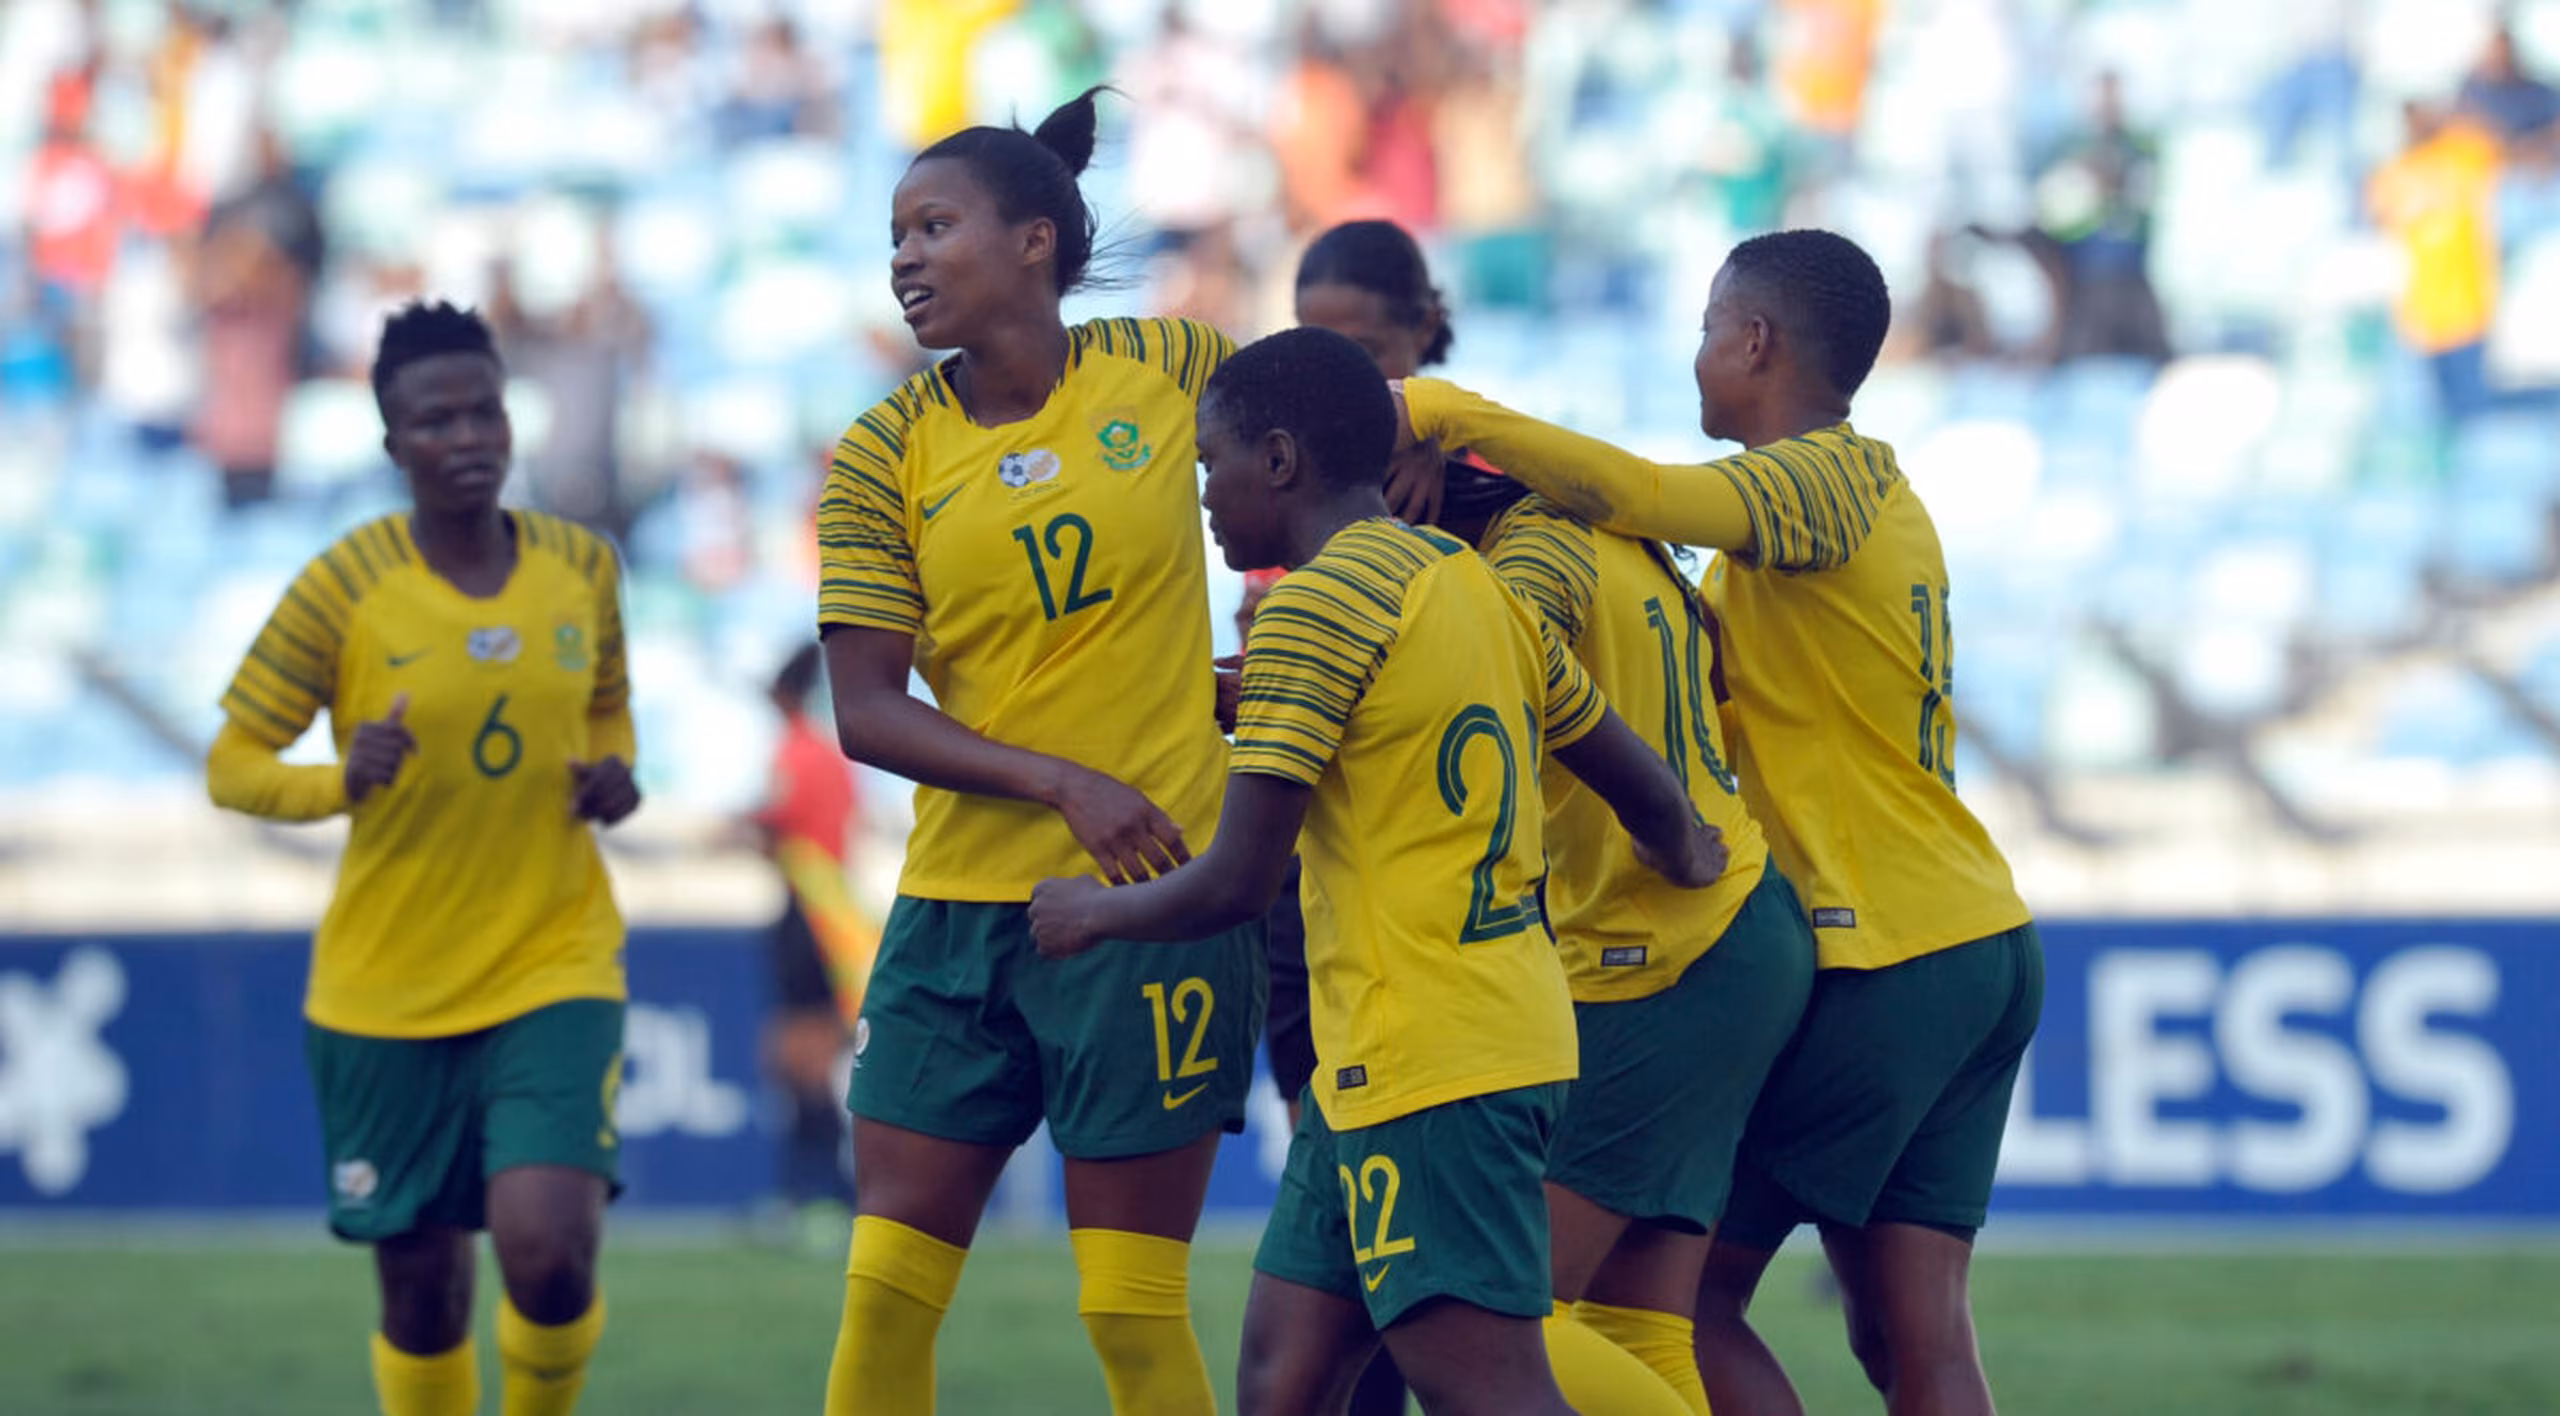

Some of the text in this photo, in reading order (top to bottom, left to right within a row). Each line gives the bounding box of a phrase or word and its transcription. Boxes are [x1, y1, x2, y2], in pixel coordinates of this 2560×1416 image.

[1012, 513, 1113, 621] 12
[472, 692, 523, 779] 6
[1436, 703, 1541, 944] 2
[1142, 976, 1218, 1082] 12
[1339, 1154, 1416, 1265] 22
